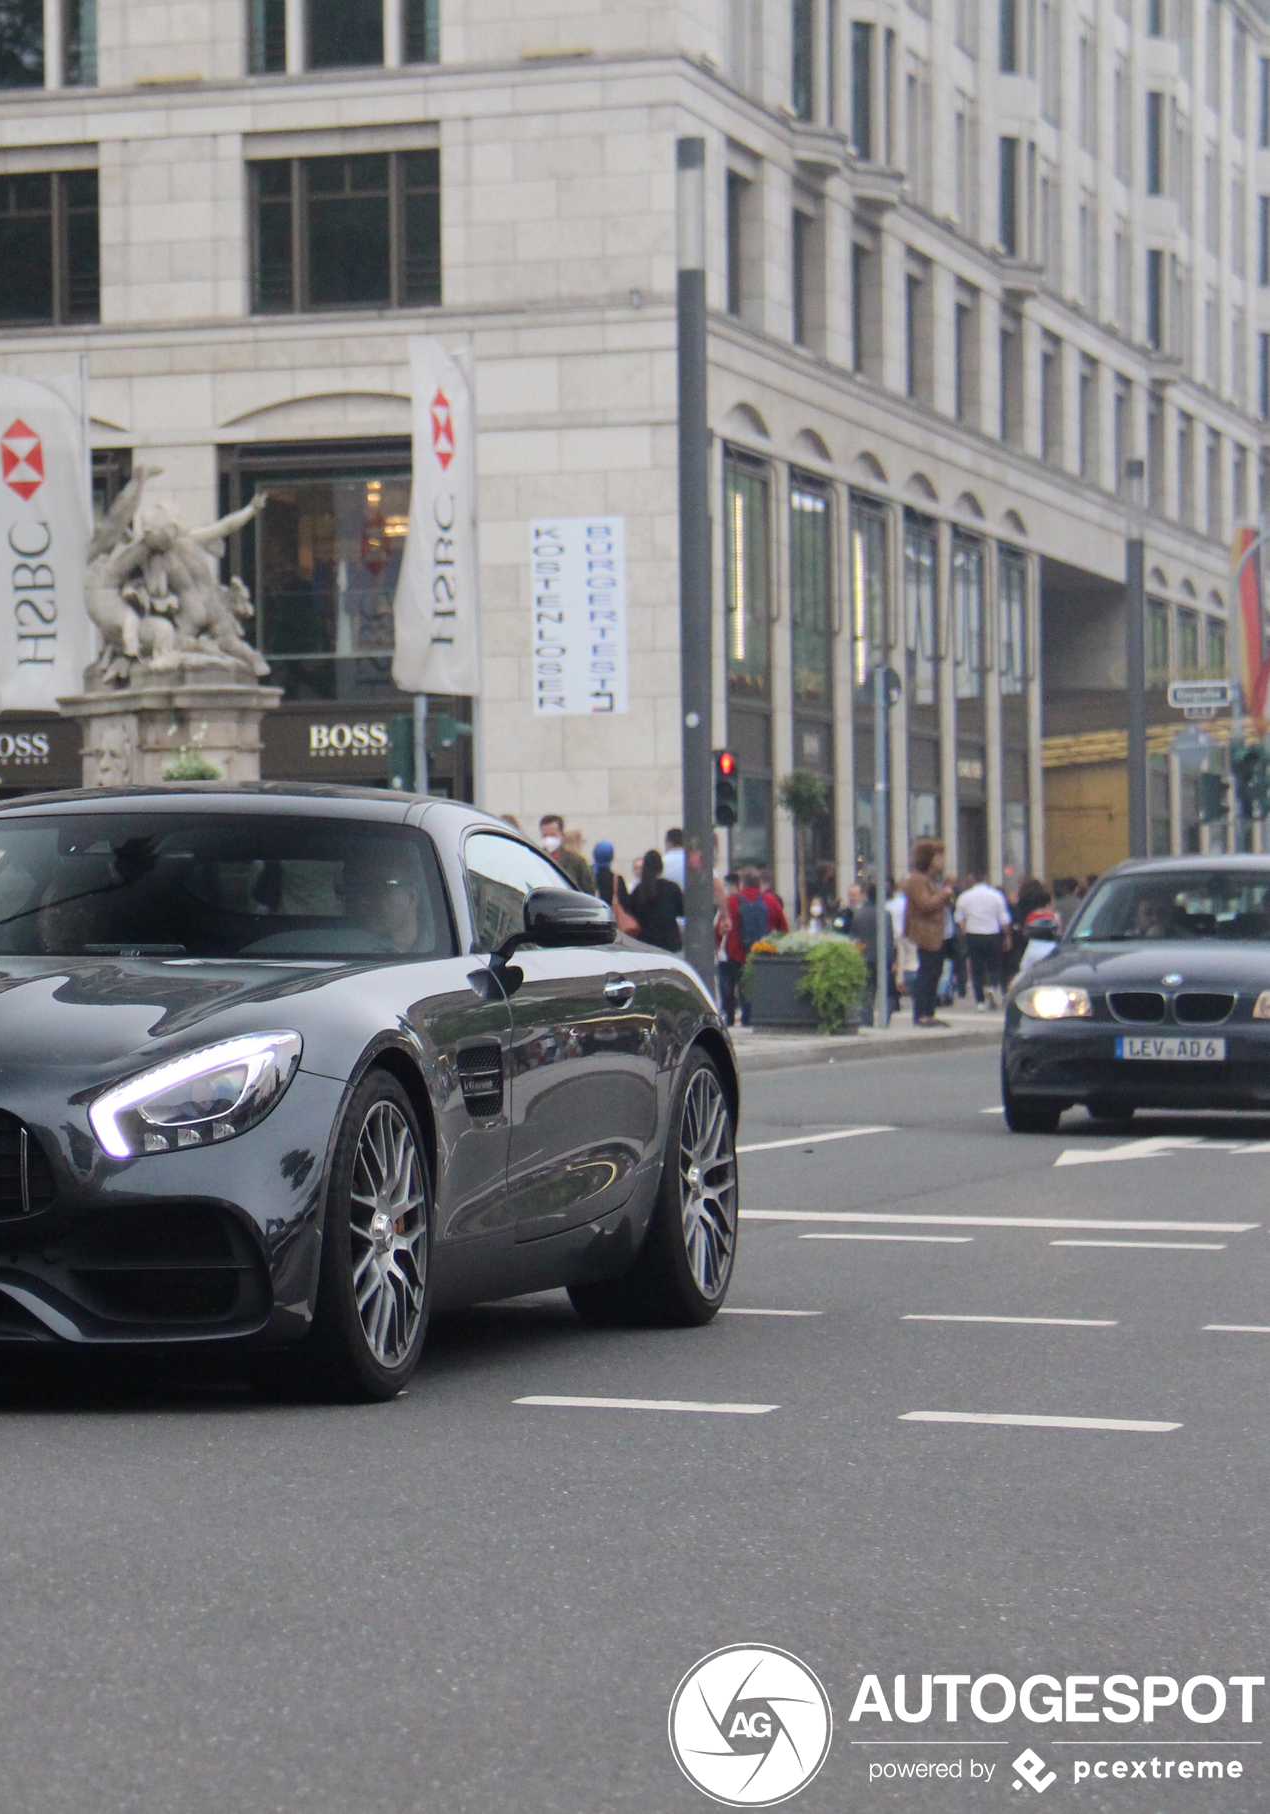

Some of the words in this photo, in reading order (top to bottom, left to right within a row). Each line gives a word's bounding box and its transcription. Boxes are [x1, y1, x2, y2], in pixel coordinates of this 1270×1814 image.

[533, 526, 566, 709] KOSTENLOSER
[309, 722, 389, 750] BOSS
[1129, 1039, 1165, 1057] LEV
[1177, 1040, 1201, 1058] AD
[1205, 1040, 1216, 1059] 6
